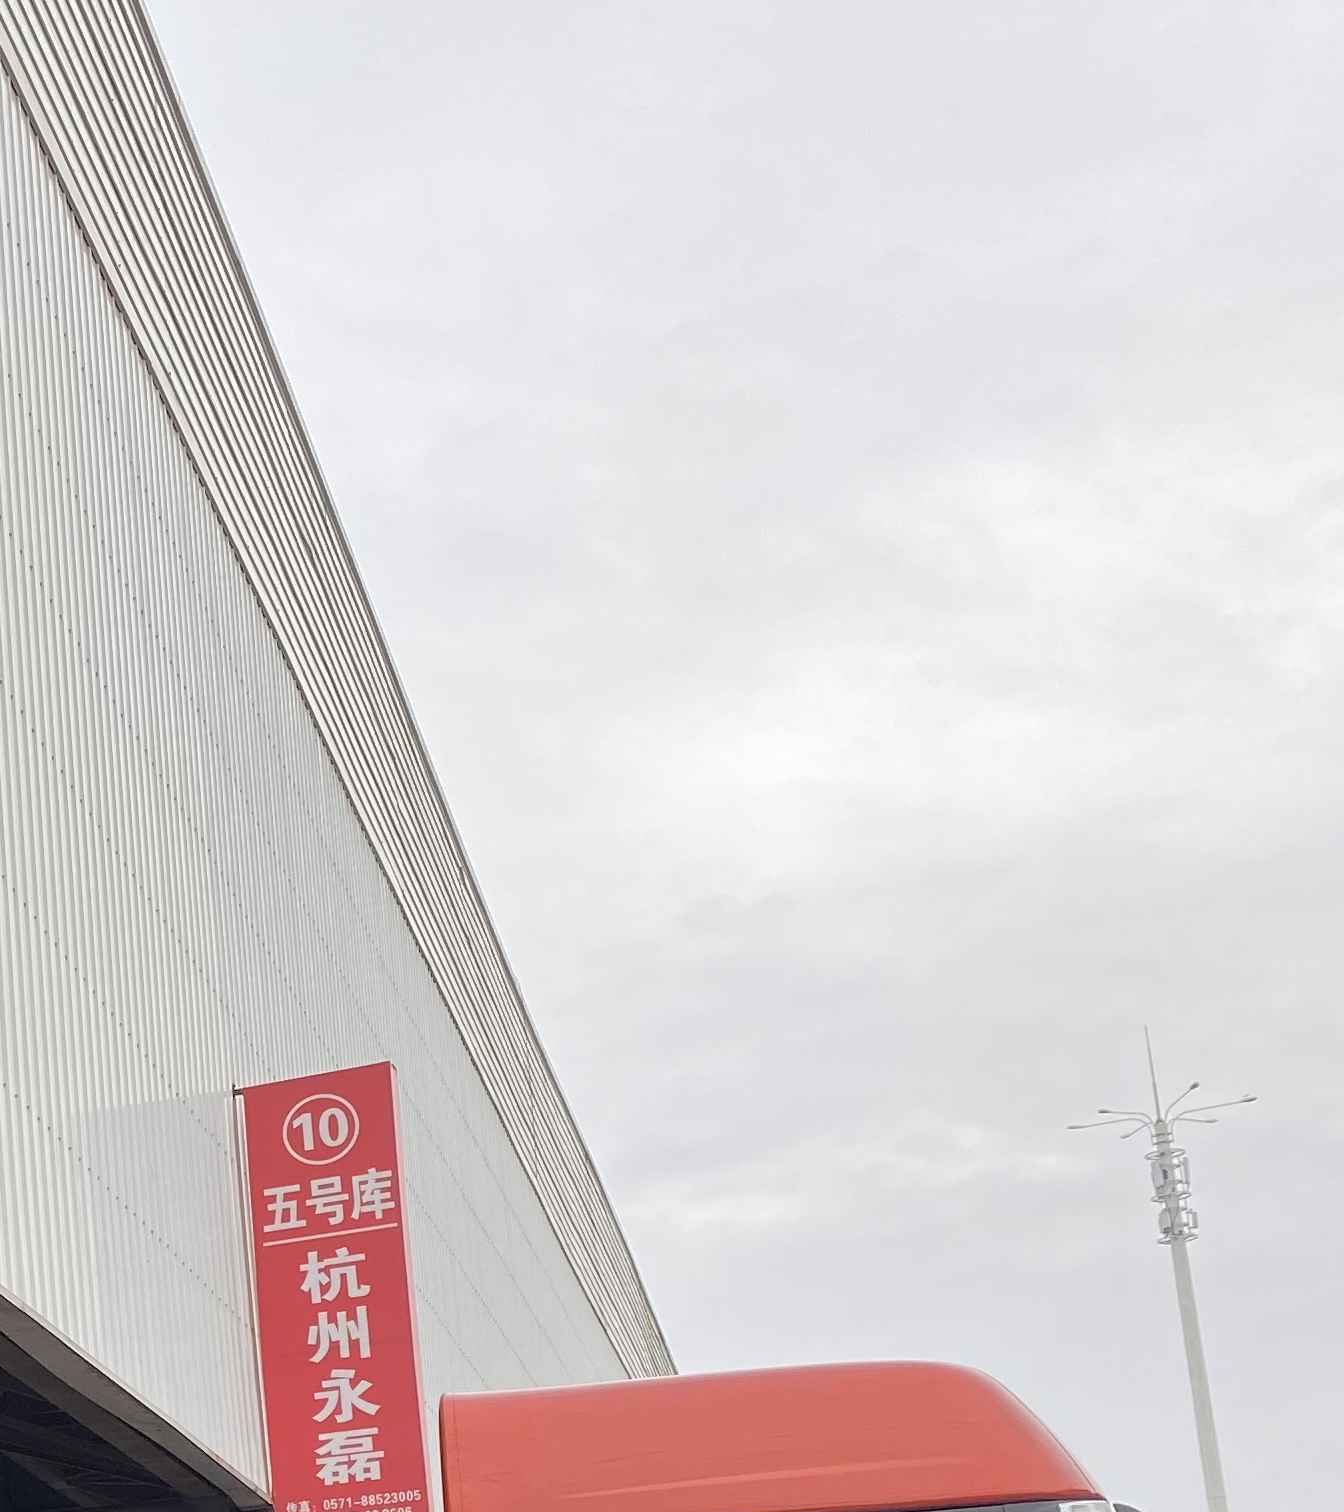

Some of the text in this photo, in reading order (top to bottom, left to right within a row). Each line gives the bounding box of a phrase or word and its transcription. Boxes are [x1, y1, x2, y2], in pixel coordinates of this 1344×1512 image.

[291, 1107, 349, 1151] 10
[263, 1168, 395, 1233] 五号库
[300, 1247, 385, 1486] 杭州永磊
[323, 1489, 422, 1511] 0571-88523005
